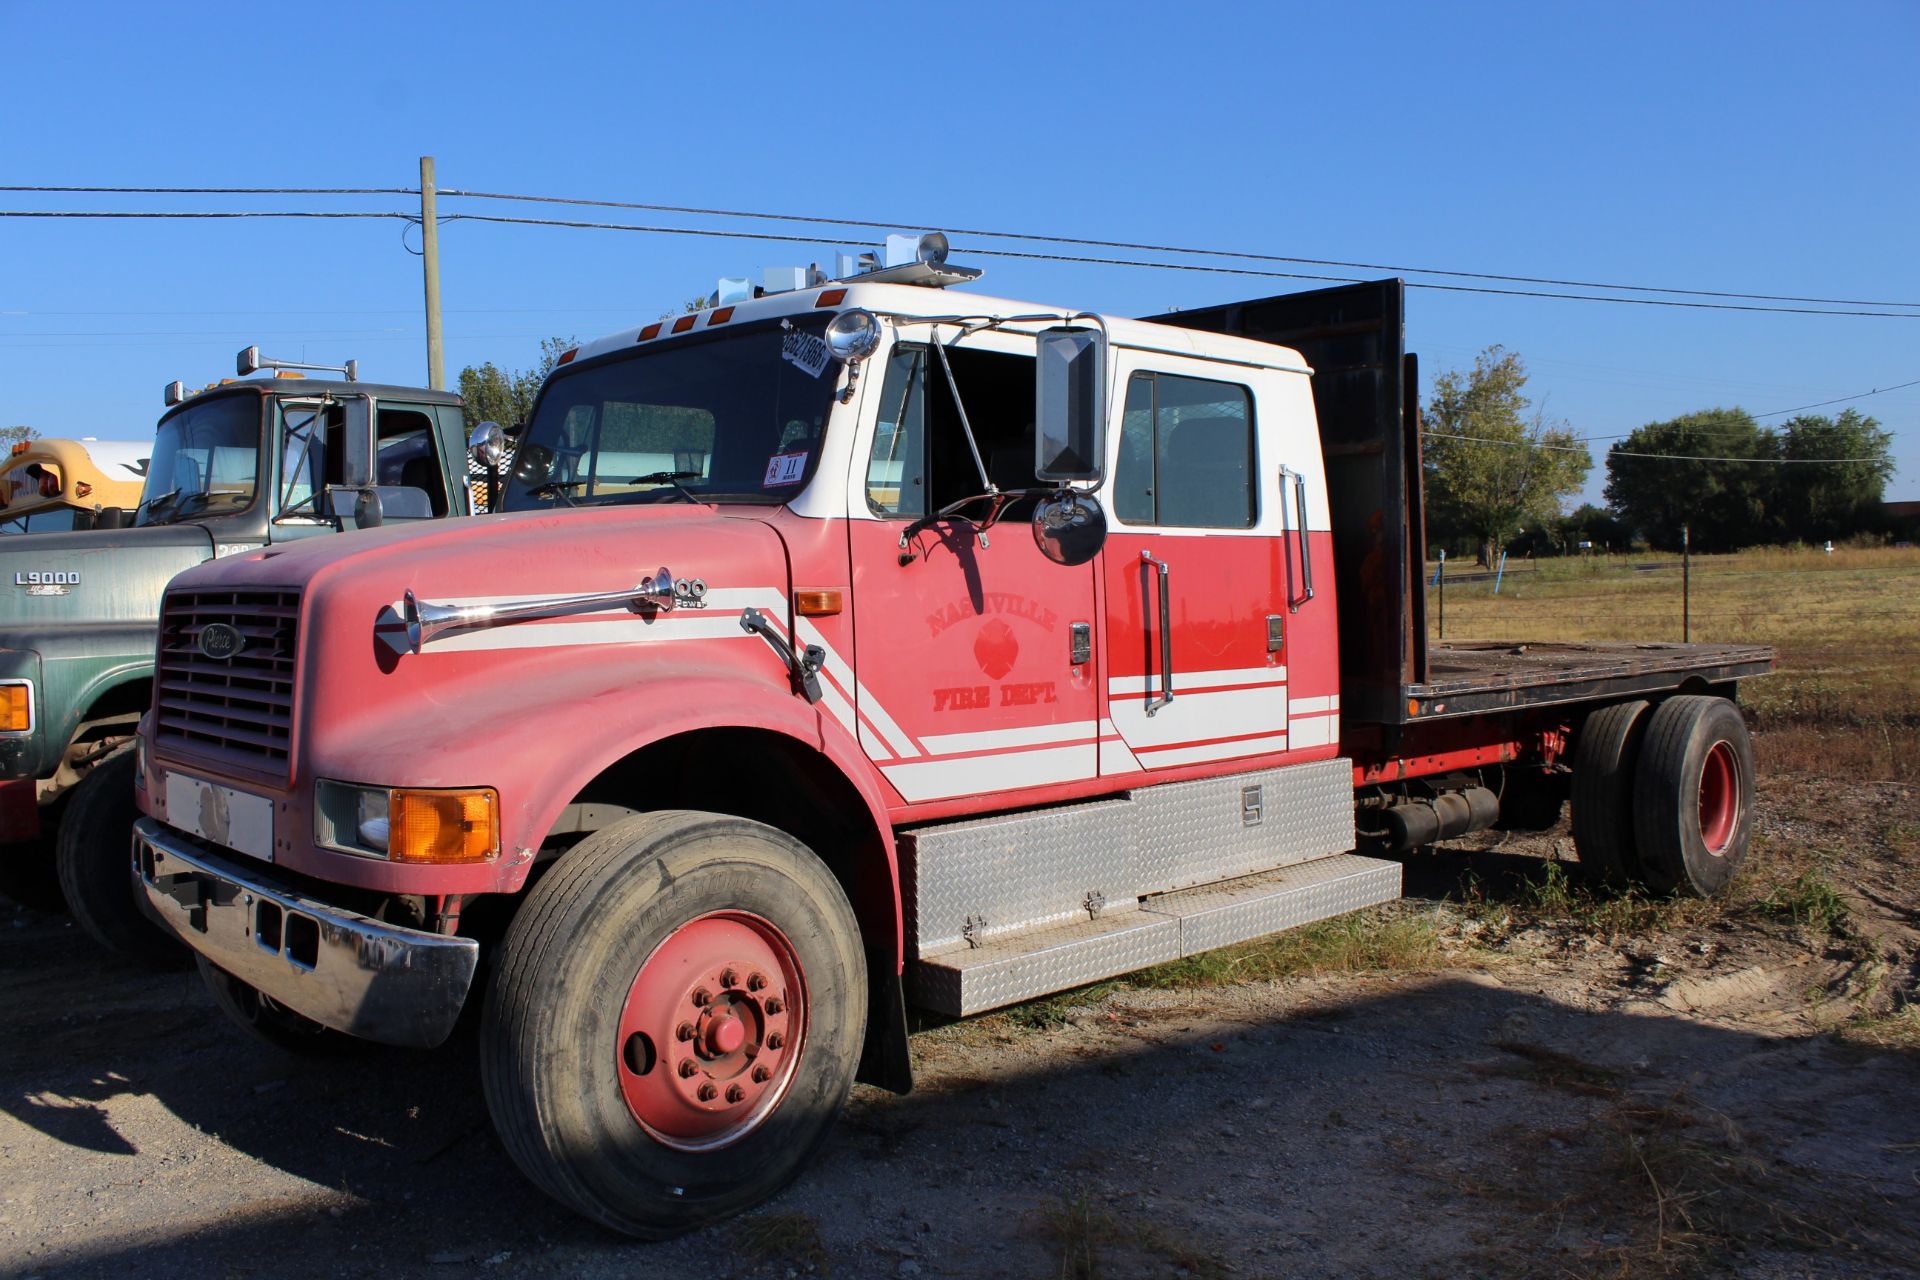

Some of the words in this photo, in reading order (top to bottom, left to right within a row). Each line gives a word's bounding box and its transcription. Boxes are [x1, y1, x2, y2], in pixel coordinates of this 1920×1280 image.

[786, 458, 797, 474] 11
[16, 571, 80, 585] L9000
[933, 686, 990, 712] FIRE
